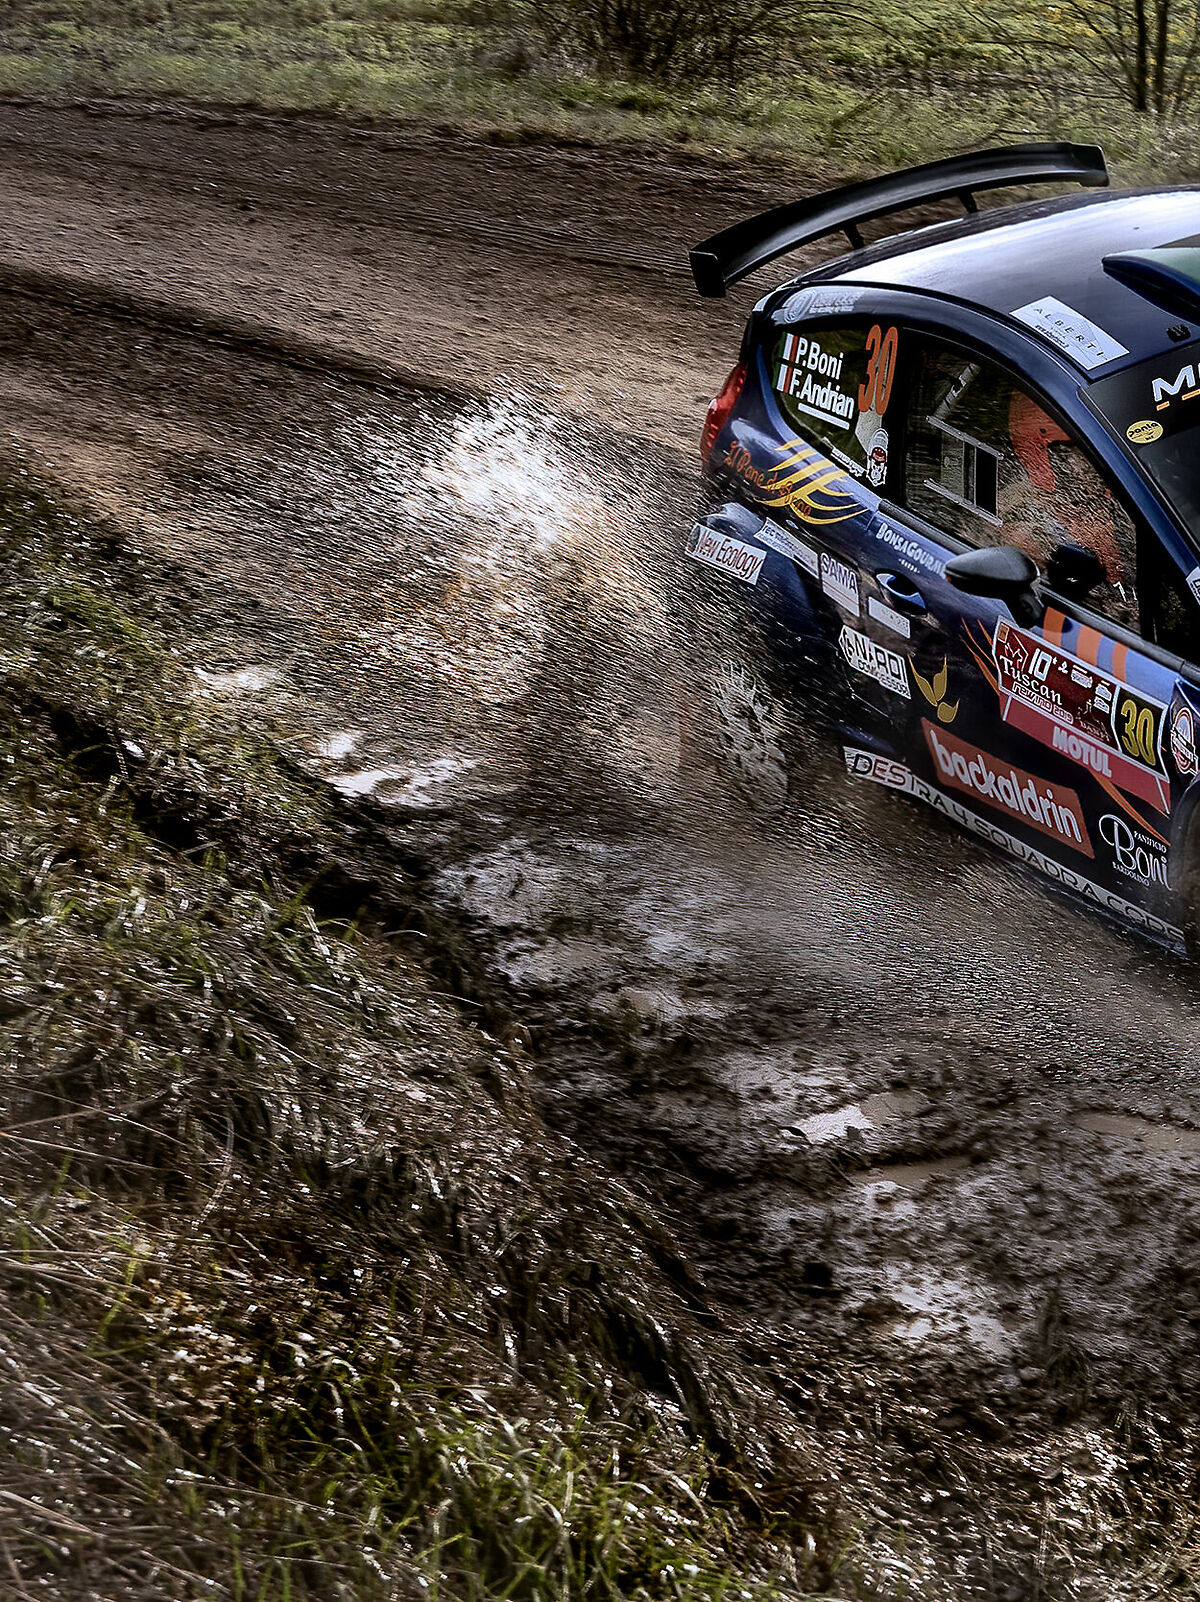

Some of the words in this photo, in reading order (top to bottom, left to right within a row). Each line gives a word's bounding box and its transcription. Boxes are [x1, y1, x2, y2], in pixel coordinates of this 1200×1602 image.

[1033, 308, 1104, 357] ALBERTI
[795, 337, 844, 380] P.Boni
[858, 324, 899, 416] 30
[789, 371, 855, 419] F.Andrian
[716, 538, 764, 580] Ecology
[820, 553, 857, 594] SAMA
[999, 655, 1063, 706] Tuscan
[1052, 726, 1113, 778] MOTUL
[1121, 699, 1156, 767] 30
[931, 730, 1083, 844] backaldrin
[952, 804, 969, 825] 4
[974, 821, 1101, 903] SQUADRA
[1099, 814, 1172, 891] Boni
